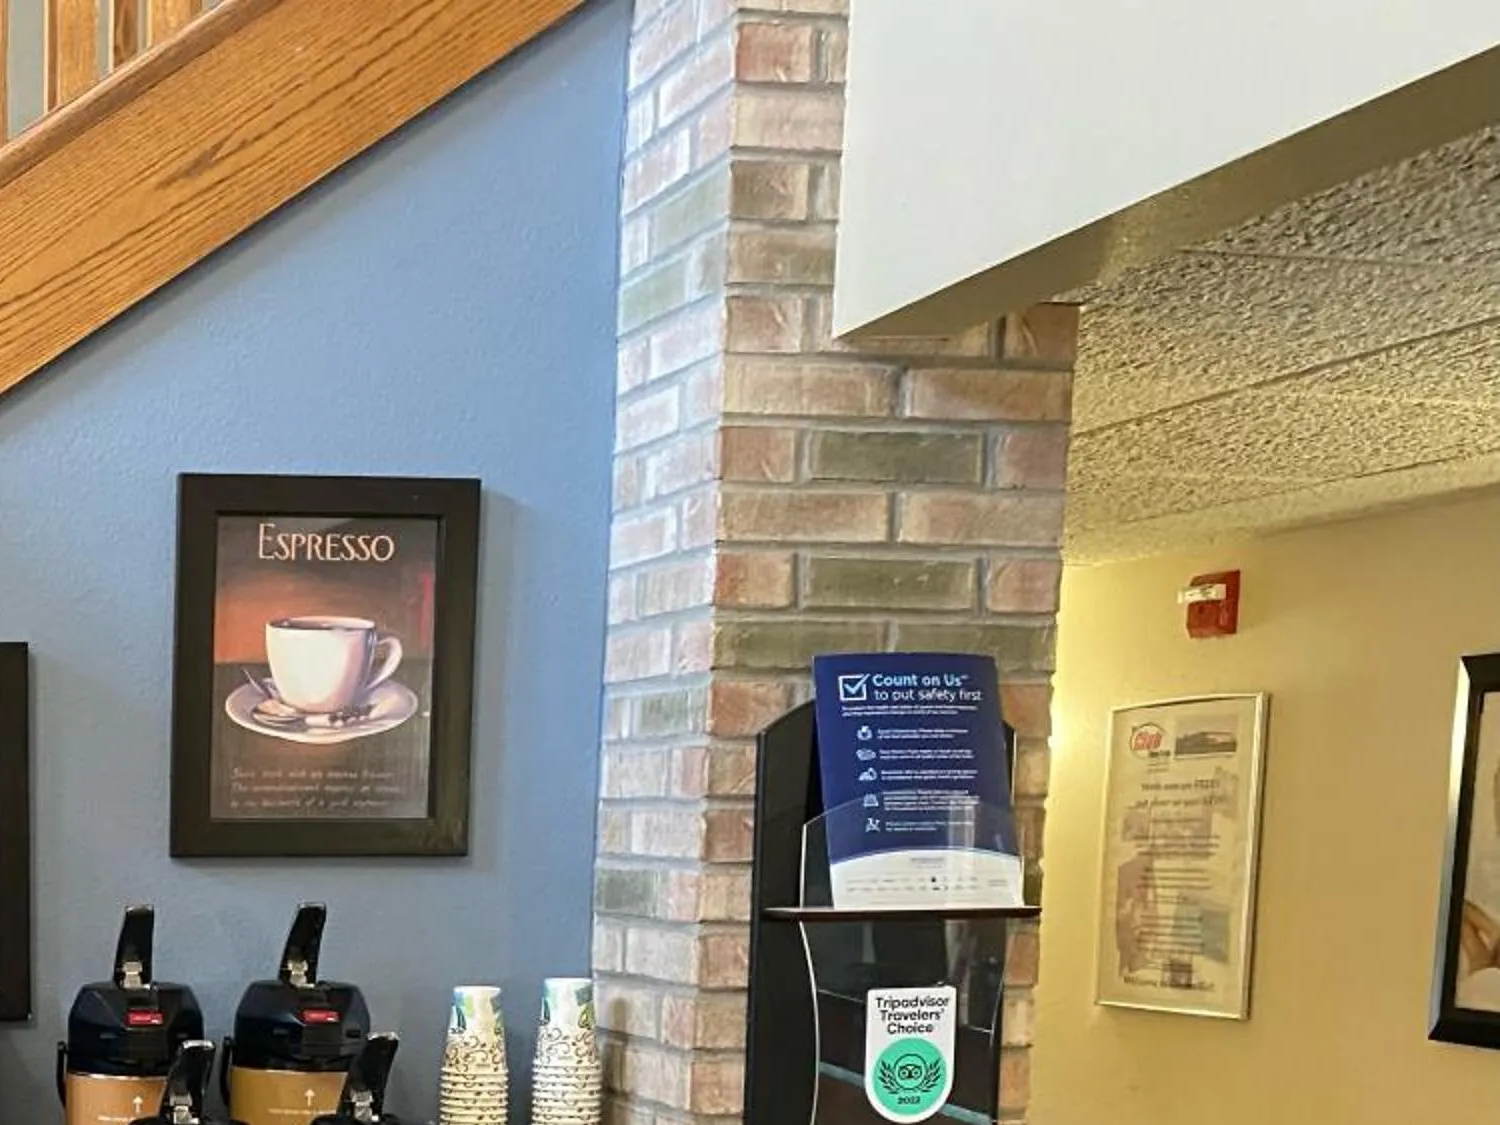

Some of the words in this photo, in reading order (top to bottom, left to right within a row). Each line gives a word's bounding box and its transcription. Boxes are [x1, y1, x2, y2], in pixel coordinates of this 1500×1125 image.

[258, 522, 395, 562] ESPRESSO
[872, 673, 918, 687] Count
[921, 677, 941, 687] on
[874, 689, 889, 701] to
[891, 688, 915, 703] put
[918, 687, 956, 703] safety
[959, 687, 982, 702] first
[875, 995, 949, 1011] Tripadvisor
[887, 1021, 934, 1035] Choice
